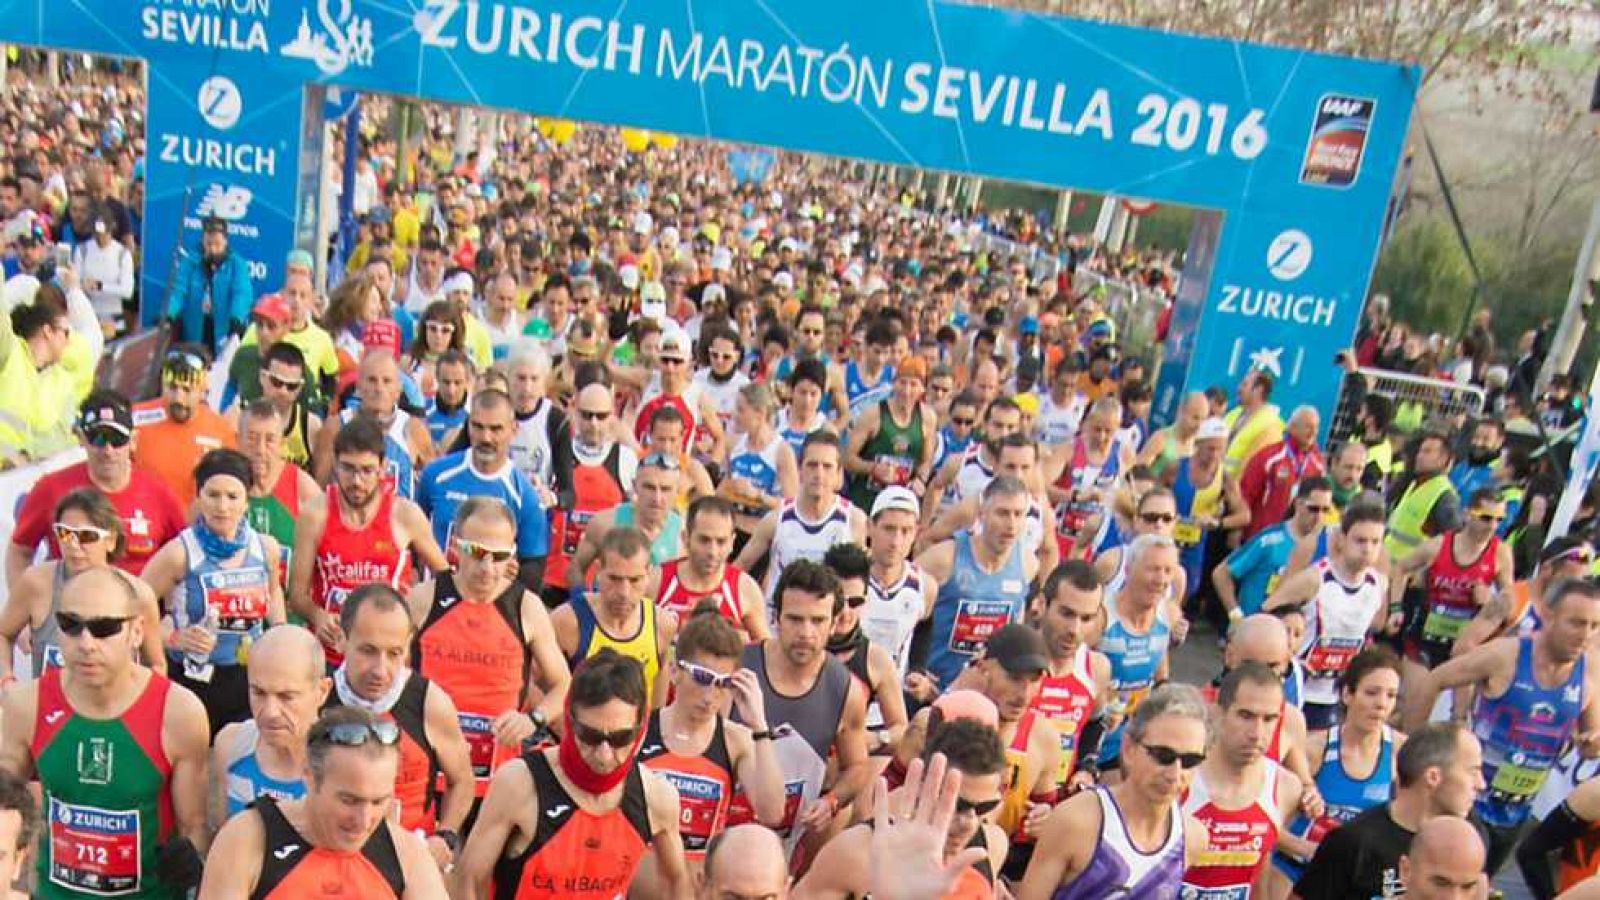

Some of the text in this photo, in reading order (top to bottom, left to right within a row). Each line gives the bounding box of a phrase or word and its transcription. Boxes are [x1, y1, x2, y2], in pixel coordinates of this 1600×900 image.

[142, 7, 269, 53] SEVILLA
[422, 0, 1268, 161] ZURICH MARATÓN SEVILLA 2016
[160, 133, 275, 176] ZURICH
[1216, 285, 1337, 327] ZURICH
[74, 810, 128, 831] ZURICH
[76, 842, 109, 865] 712
